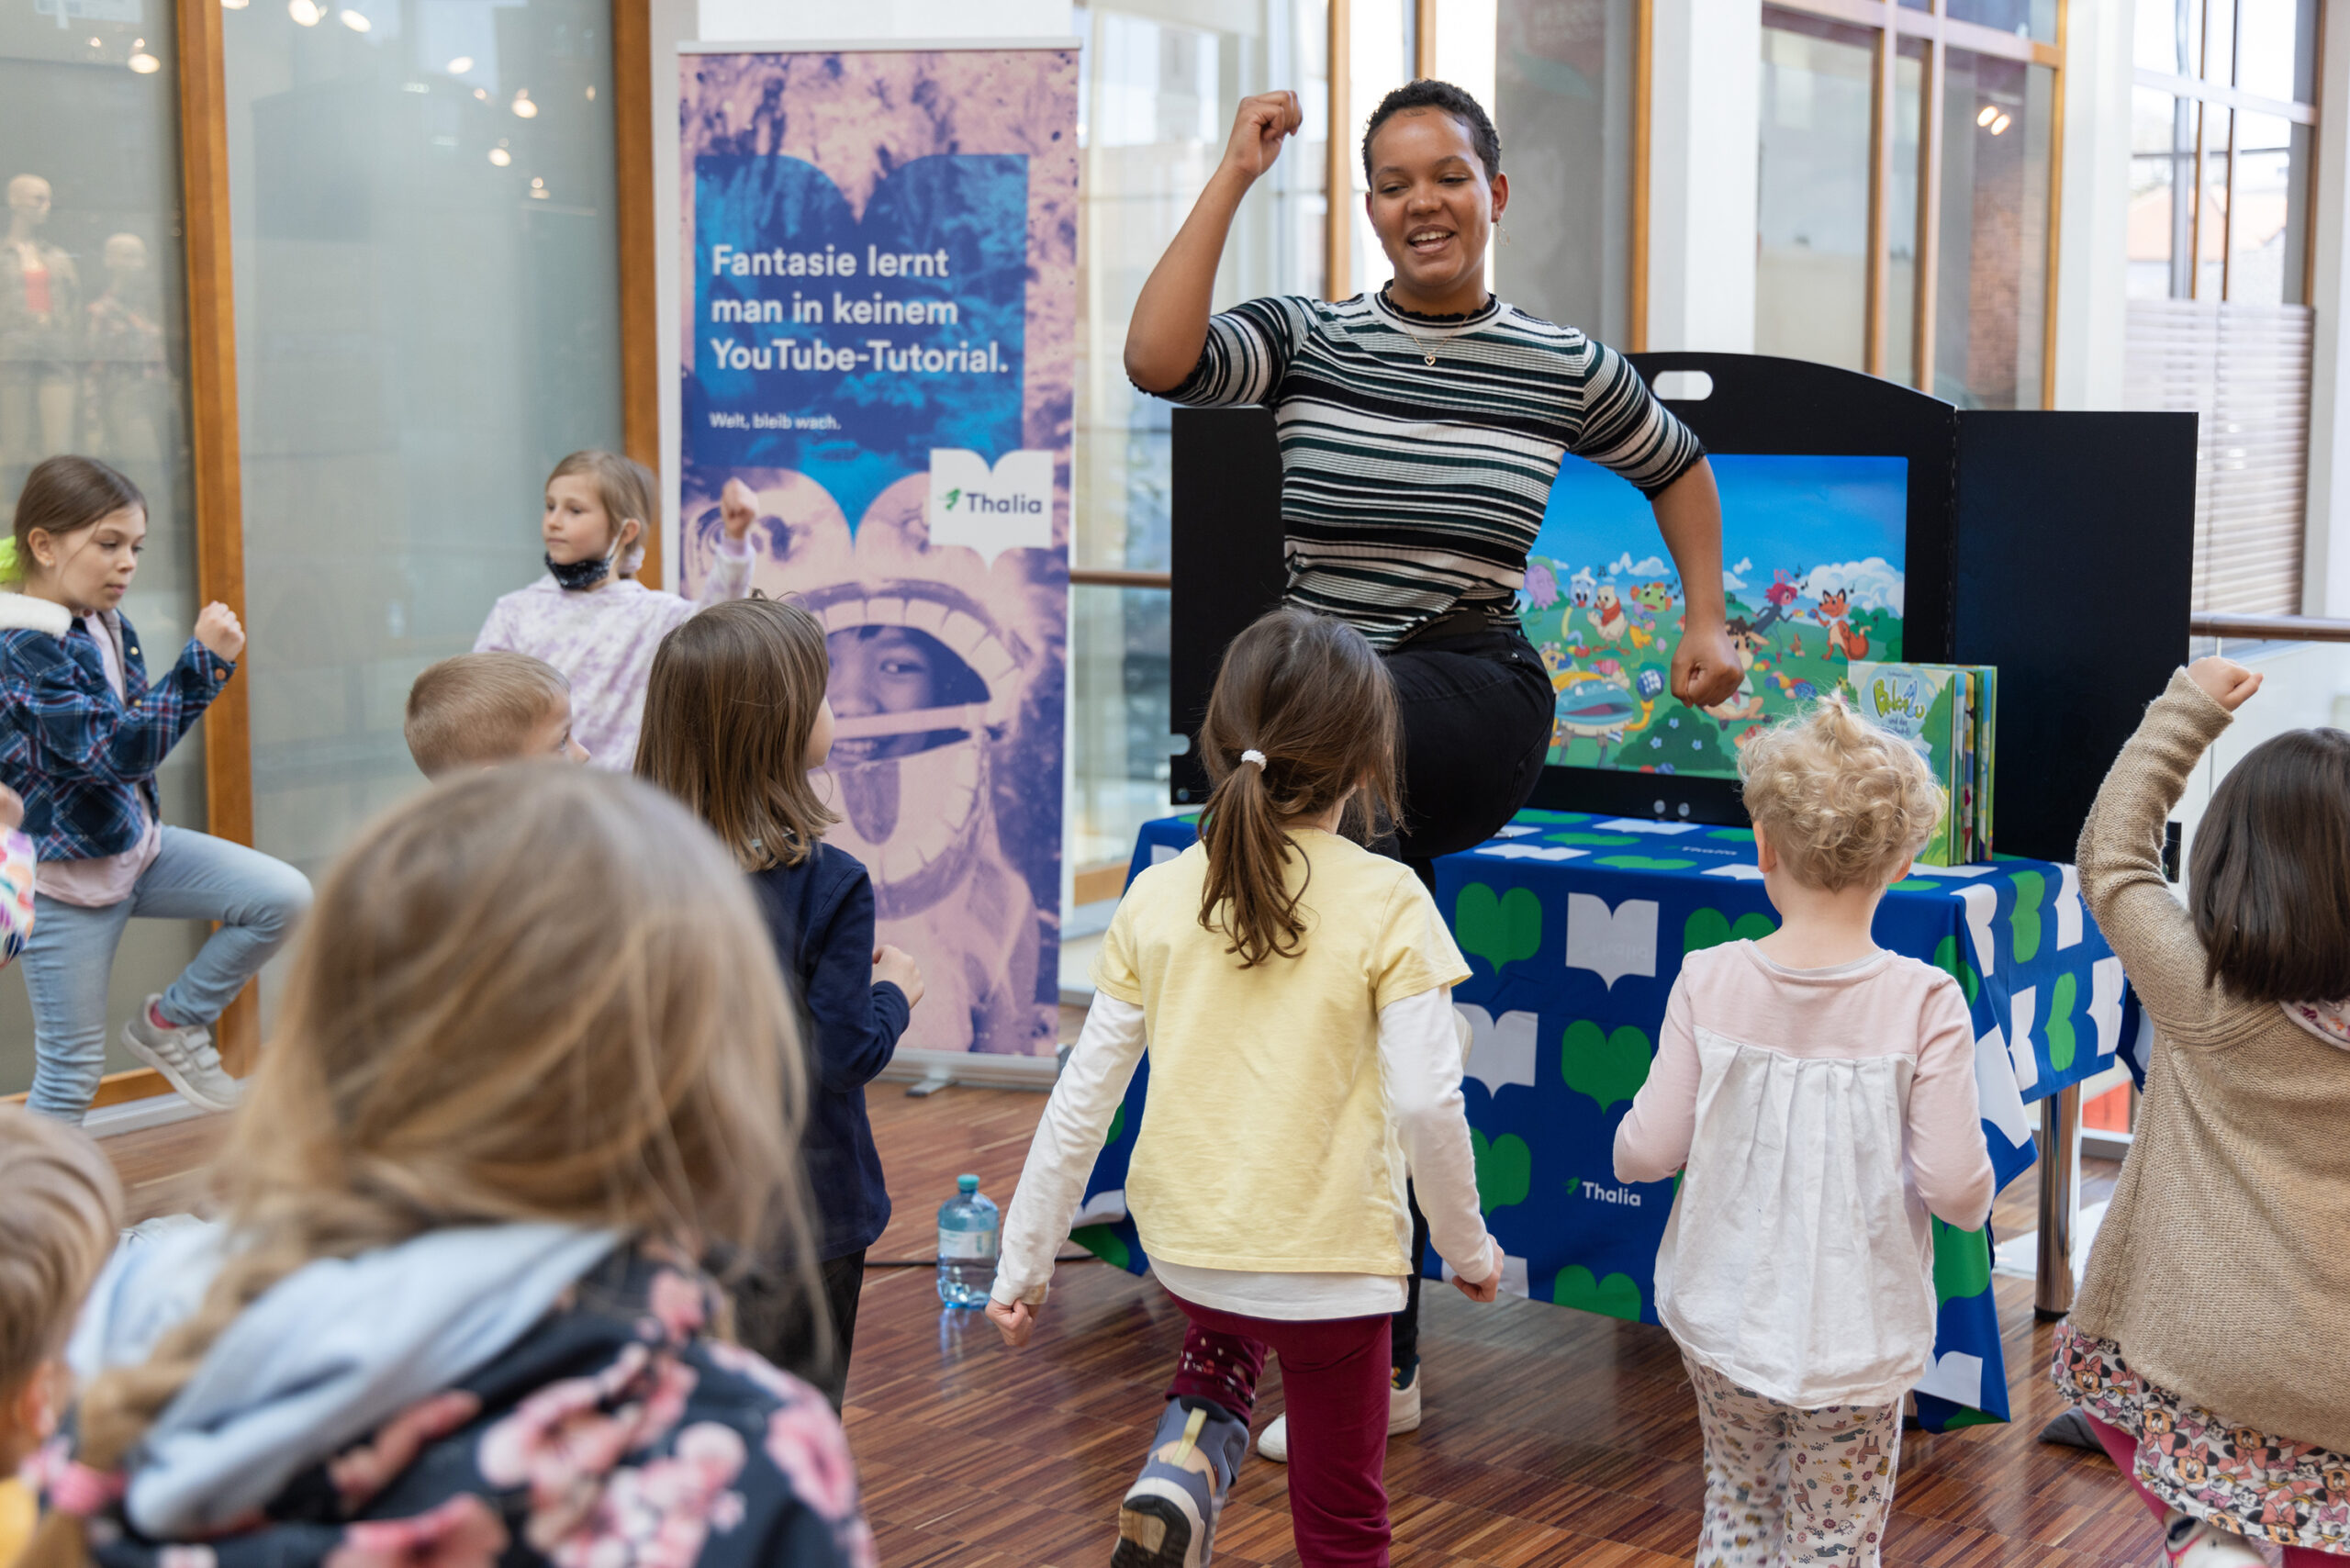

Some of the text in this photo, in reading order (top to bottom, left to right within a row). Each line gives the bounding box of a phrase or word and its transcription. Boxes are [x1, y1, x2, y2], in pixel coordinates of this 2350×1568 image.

[711, 243, 950, 277] Fantasie lernt
[711, 290, 959, 325] man in keinem
[710, 337, 1010, 374] YouTube-Tutorial.
[708, 410, 843, 431] Welt, bleib wach.
[965, 492, 1043, 514] Thalia
[1581, 1181, 1642, 1207] Thalia
